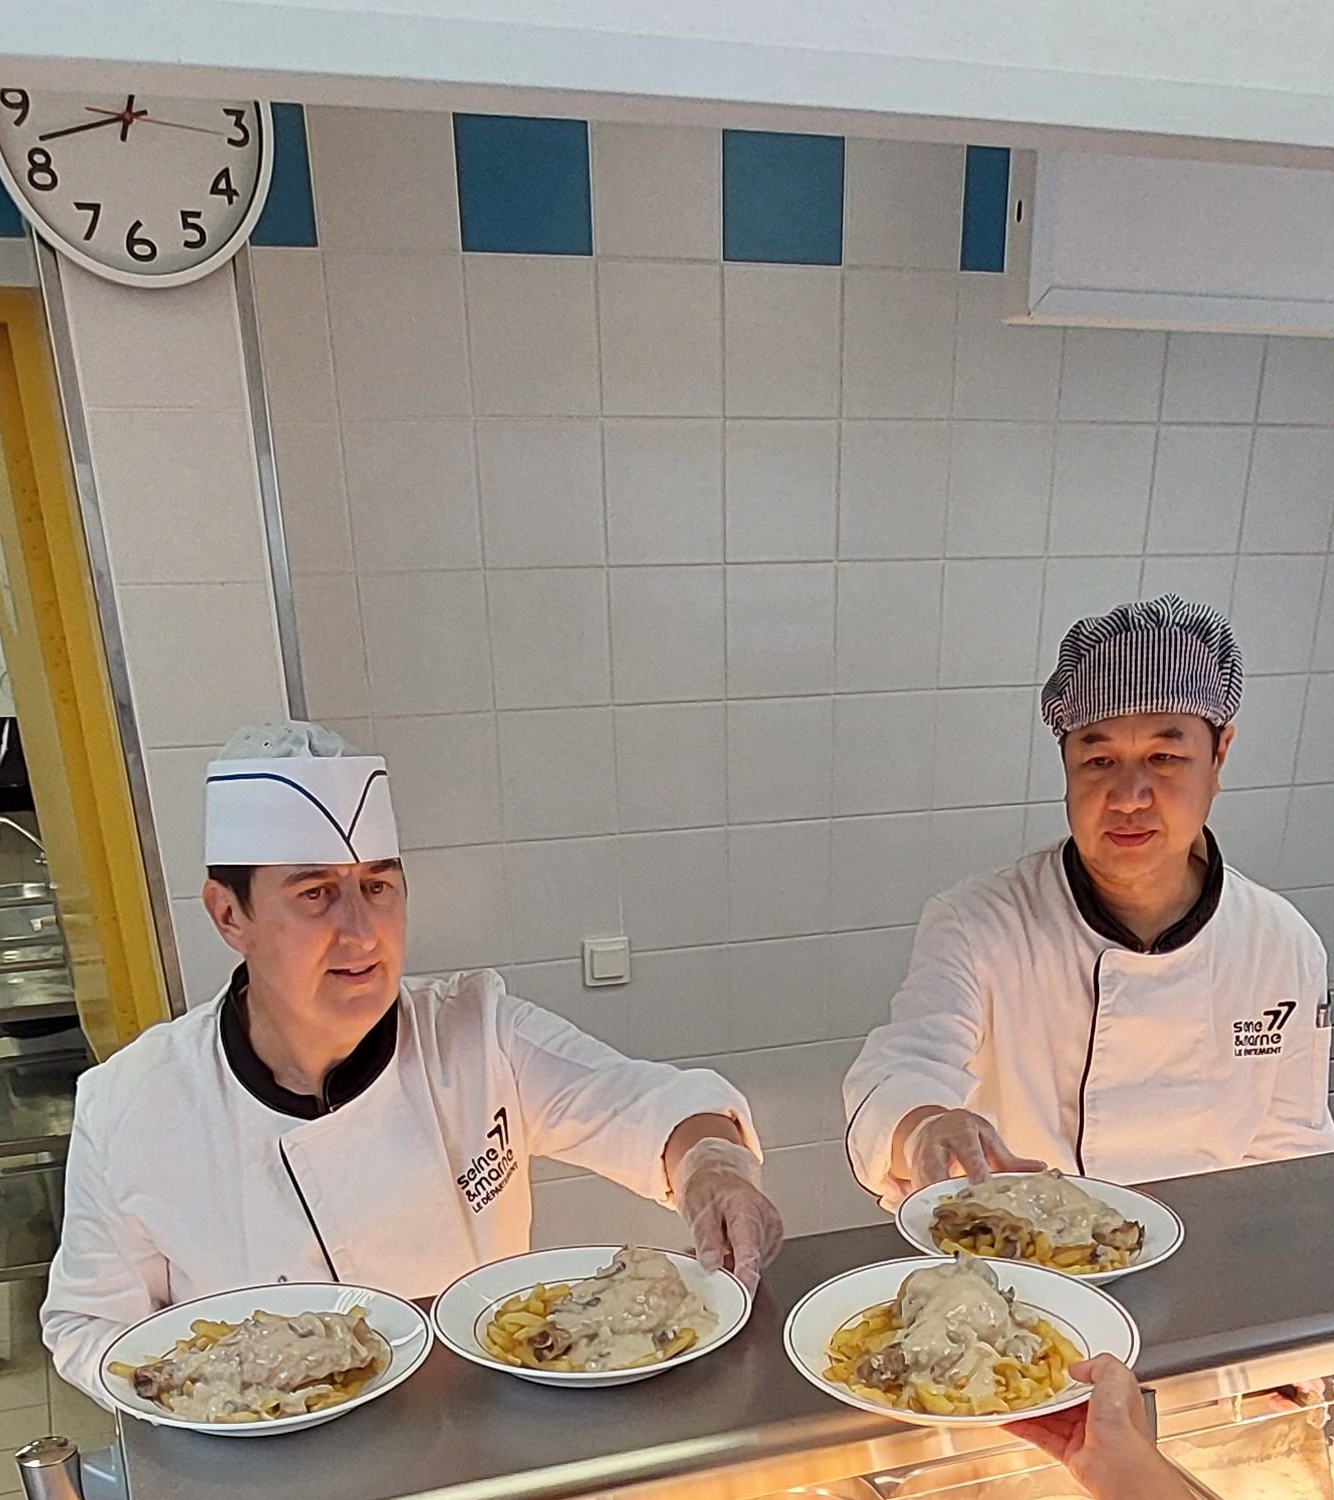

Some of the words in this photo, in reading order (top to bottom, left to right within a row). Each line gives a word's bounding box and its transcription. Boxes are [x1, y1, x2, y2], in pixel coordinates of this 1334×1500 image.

[0, 88, 30, 127] 9
[223, 108, 250, 147] 3
[27, 147, 58, 191] 8
[209, 167, 240, 206] 4
[74, 201, 102, 241] 7
[126, 219, 158, 262] 6
[180, 210, 206, 249] 5
